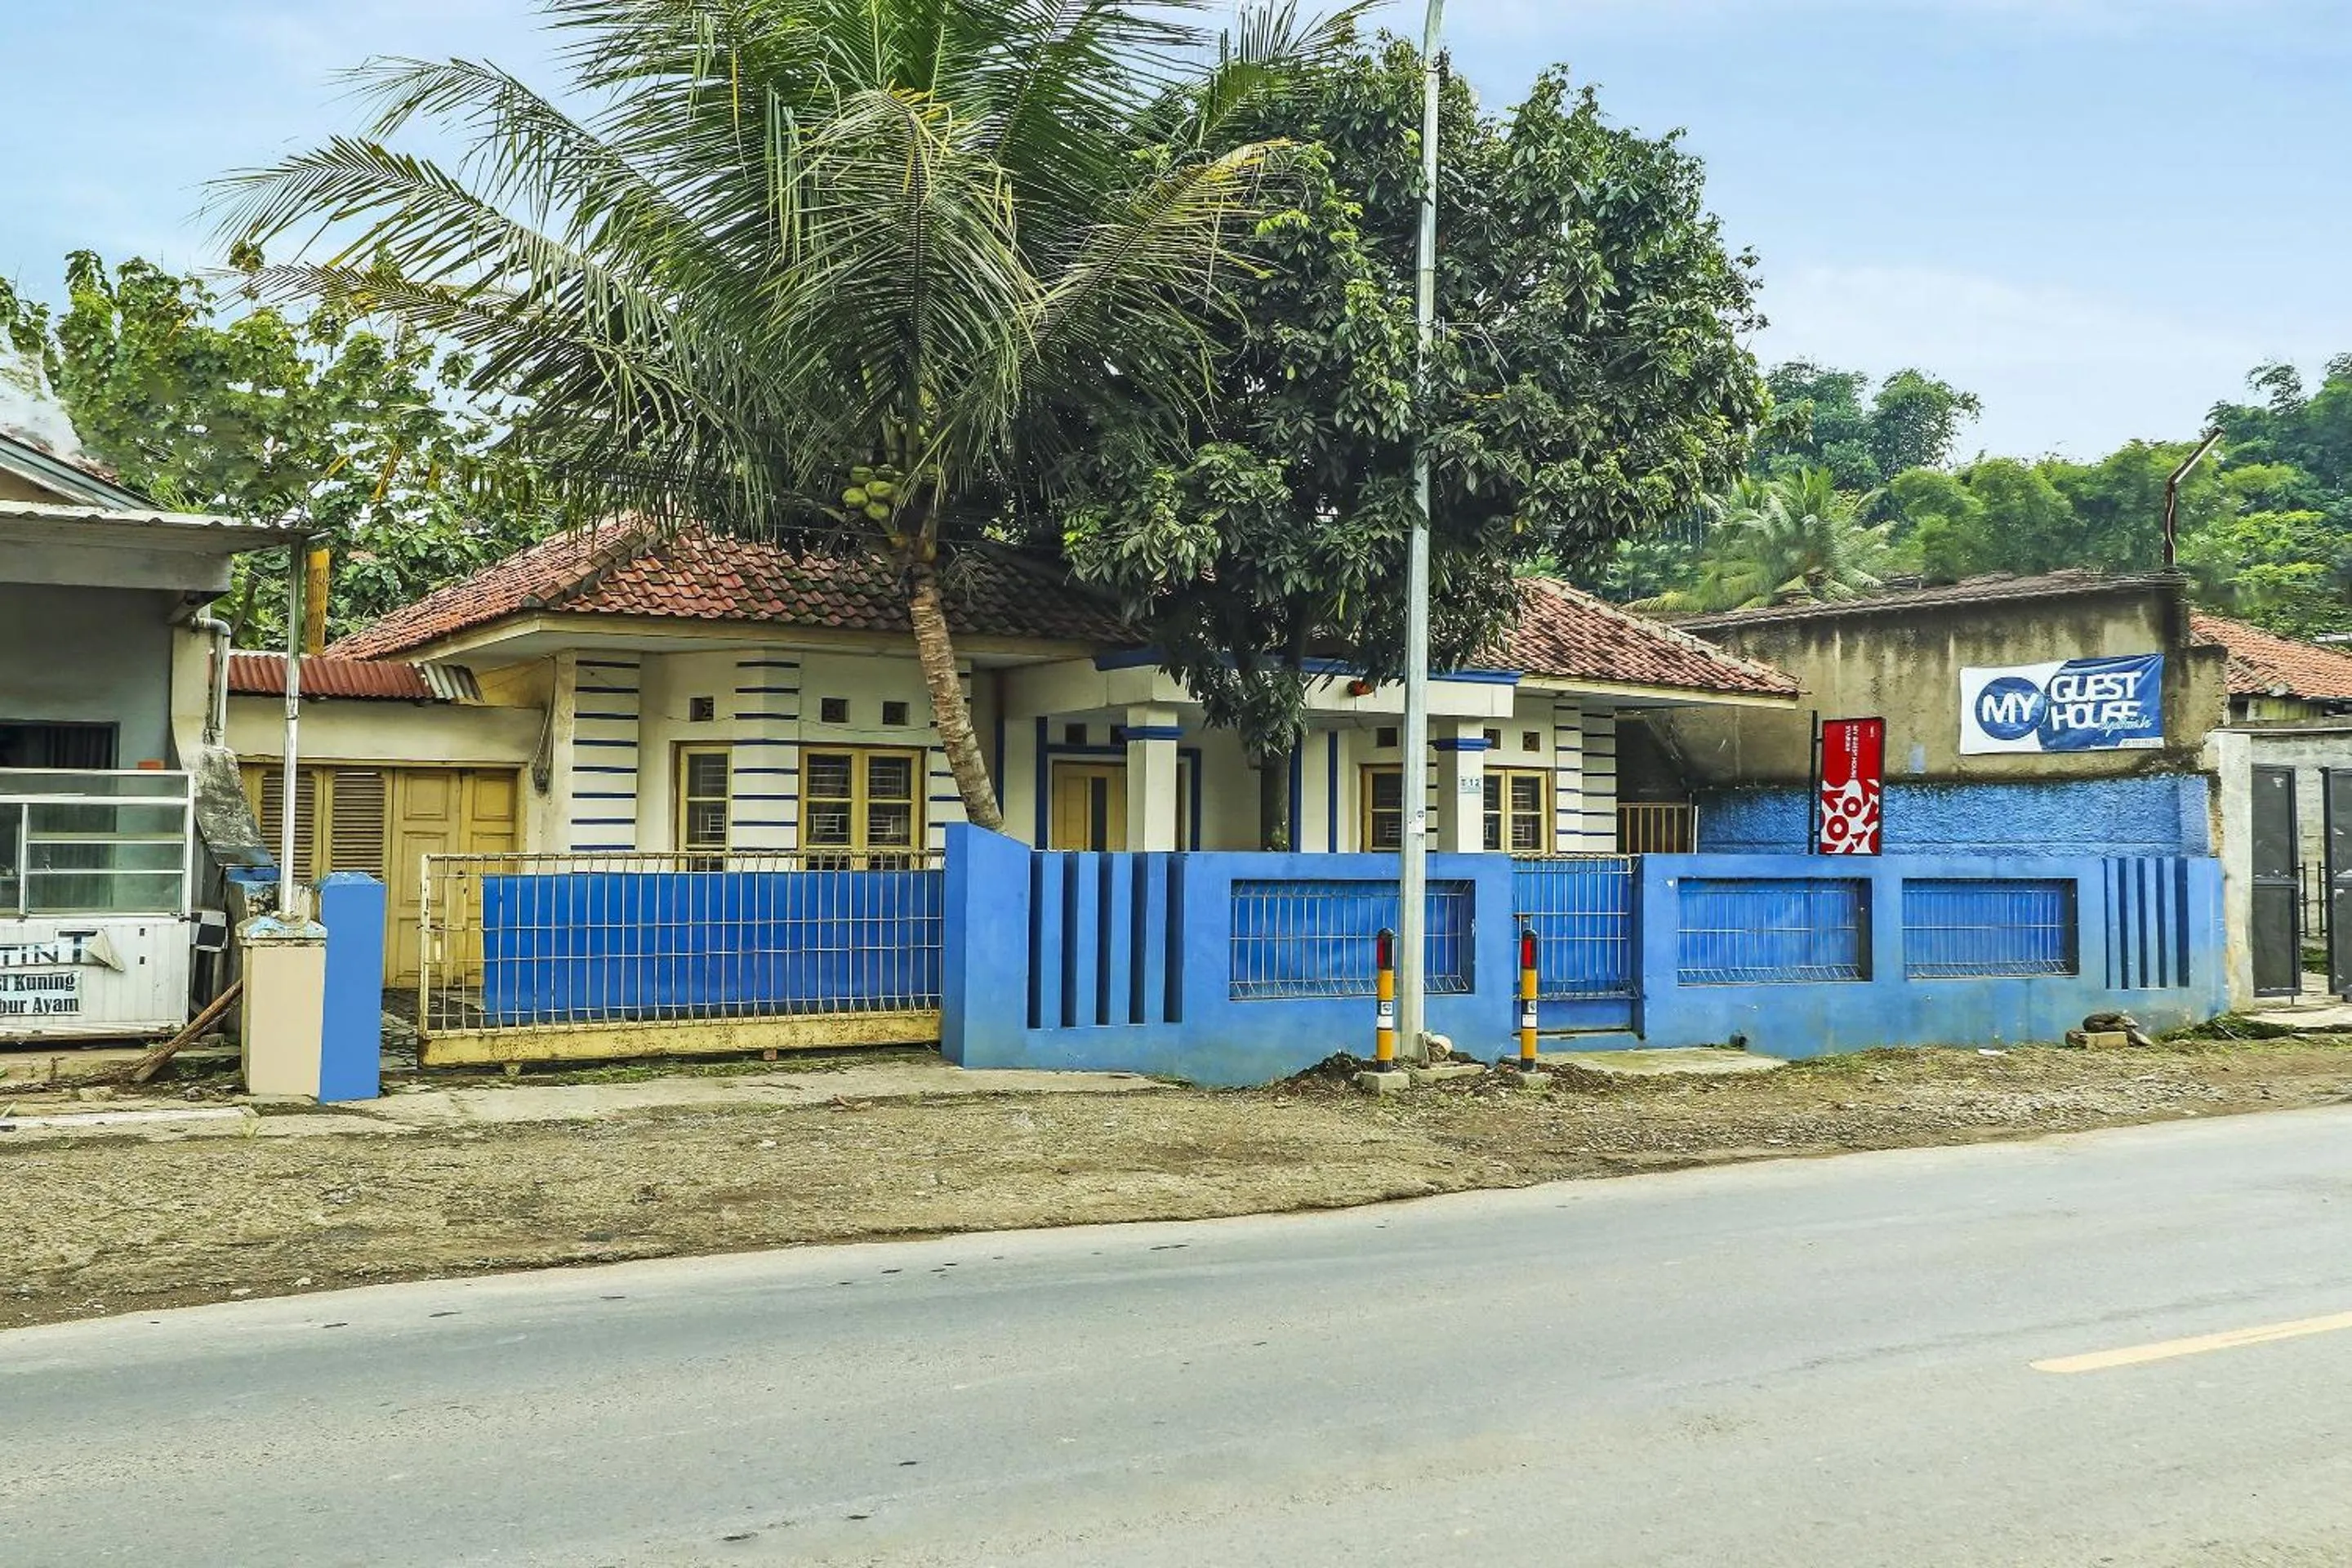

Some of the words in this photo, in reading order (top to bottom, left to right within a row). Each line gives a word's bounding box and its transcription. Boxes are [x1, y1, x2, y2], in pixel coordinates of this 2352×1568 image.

[2051, 670, 2141, 703] GUEST
[1982, 693, 2038, 724] MY
[2051, 699, 2141, 731] HOUSE
[14, 973, 75, 991] Kuning
[33, 996, 79, 1015] Ayam
